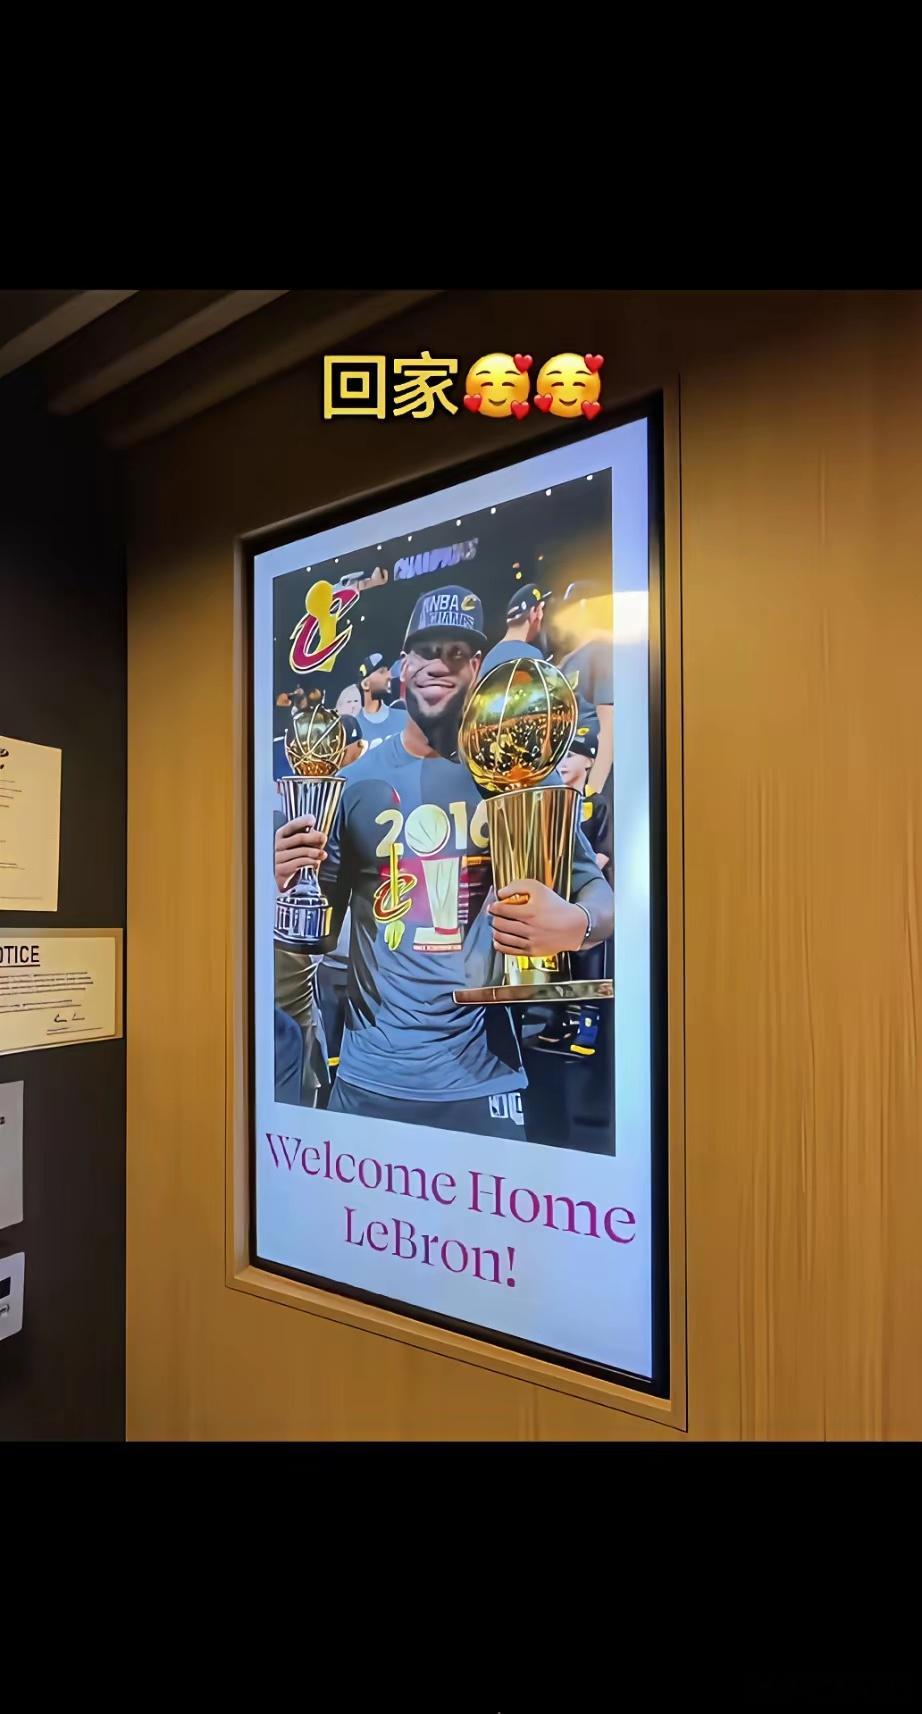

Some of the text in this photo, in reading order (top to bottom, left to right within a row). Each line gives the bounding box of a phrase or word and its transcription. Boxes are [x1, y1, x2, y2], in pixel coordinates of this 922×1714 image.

[429, 594, 459, 612] NBA
[265, 1132, 637, 1245] Welcome Home
[343, 1205, 516, 1288] LeBron!
